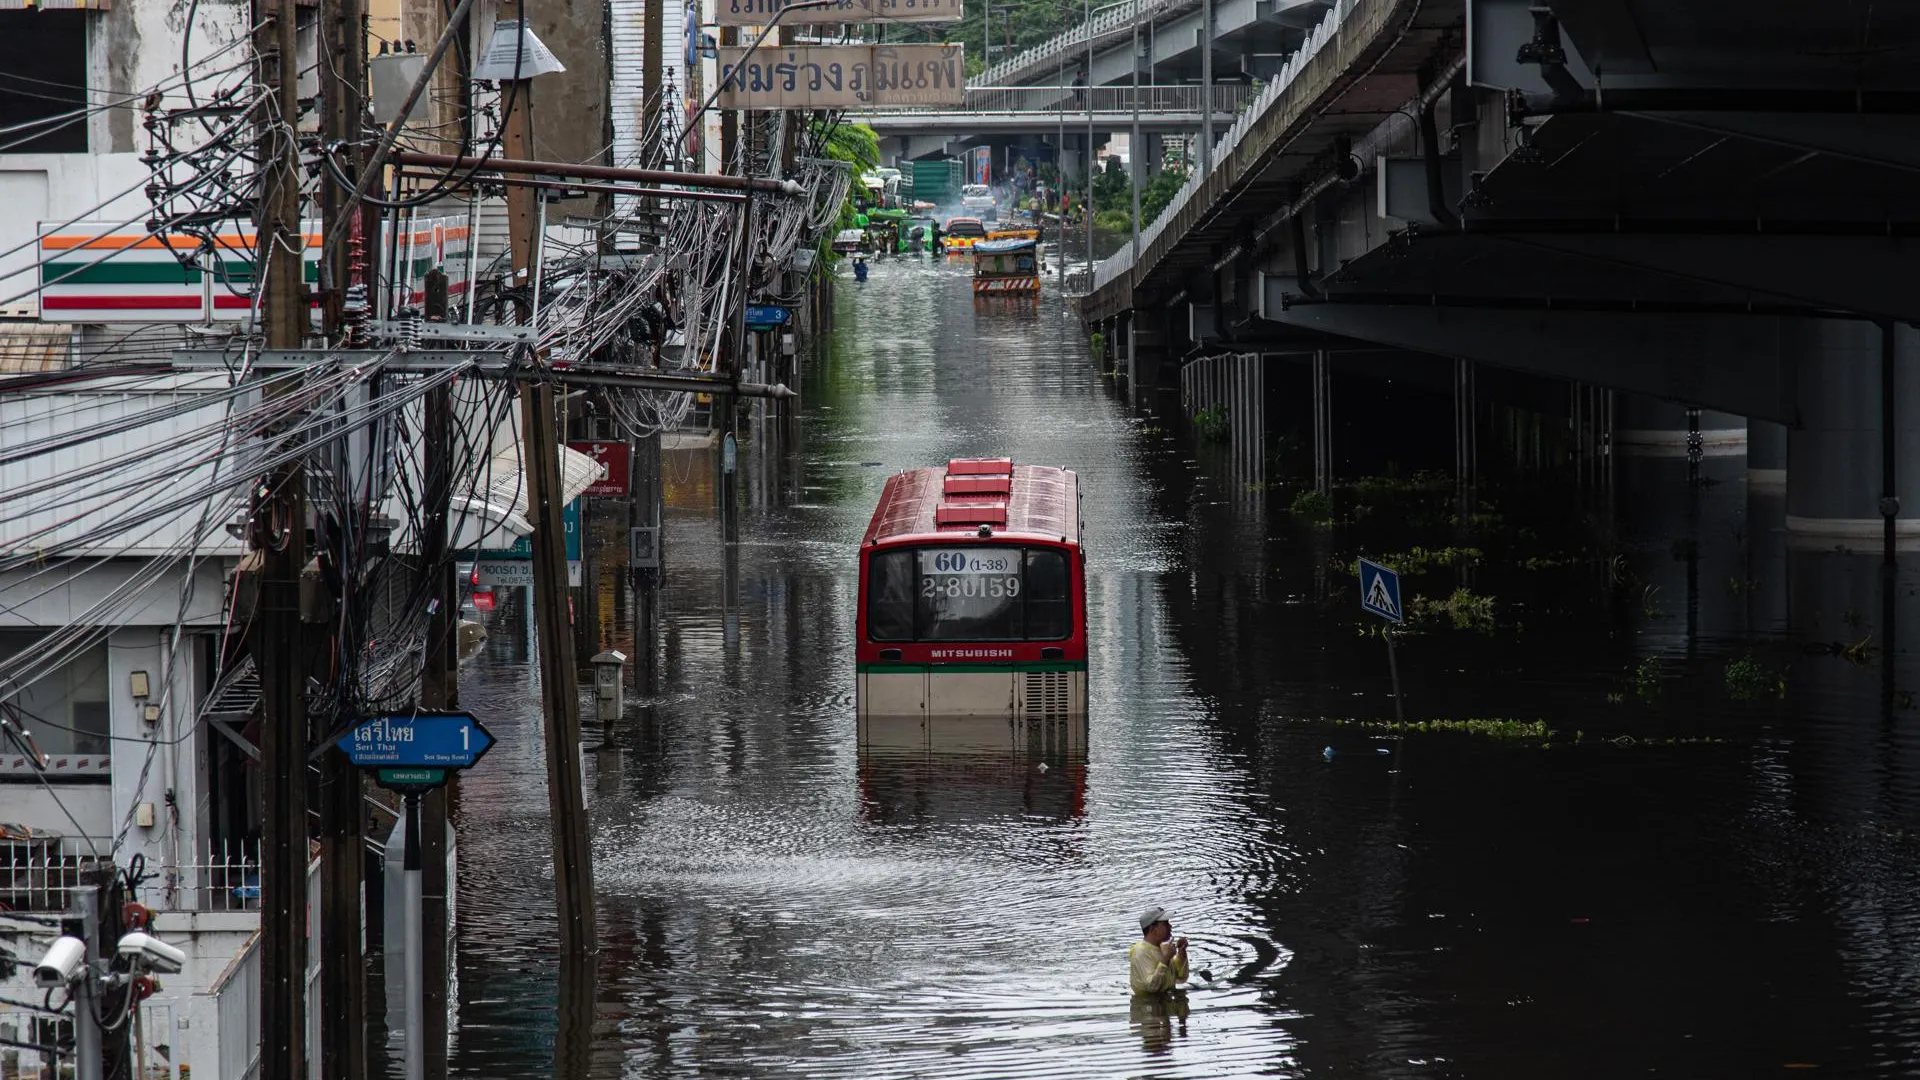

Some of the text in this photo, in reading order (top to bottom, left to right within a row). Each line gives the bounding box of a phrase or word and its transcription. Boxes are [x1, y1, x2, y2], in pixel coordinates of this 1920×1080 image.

[849, 43, 957, 102] ภูมิแพ้
[775, 310, 782, 319] 3
[935, 552, 1008, 572] 60 (1-38)
[922, 577, 1020, 598] 2-80159
[931, 649, 1013, 658] MITSUBISHI
[355, 717, 469, 750] เสรีไทย 1
